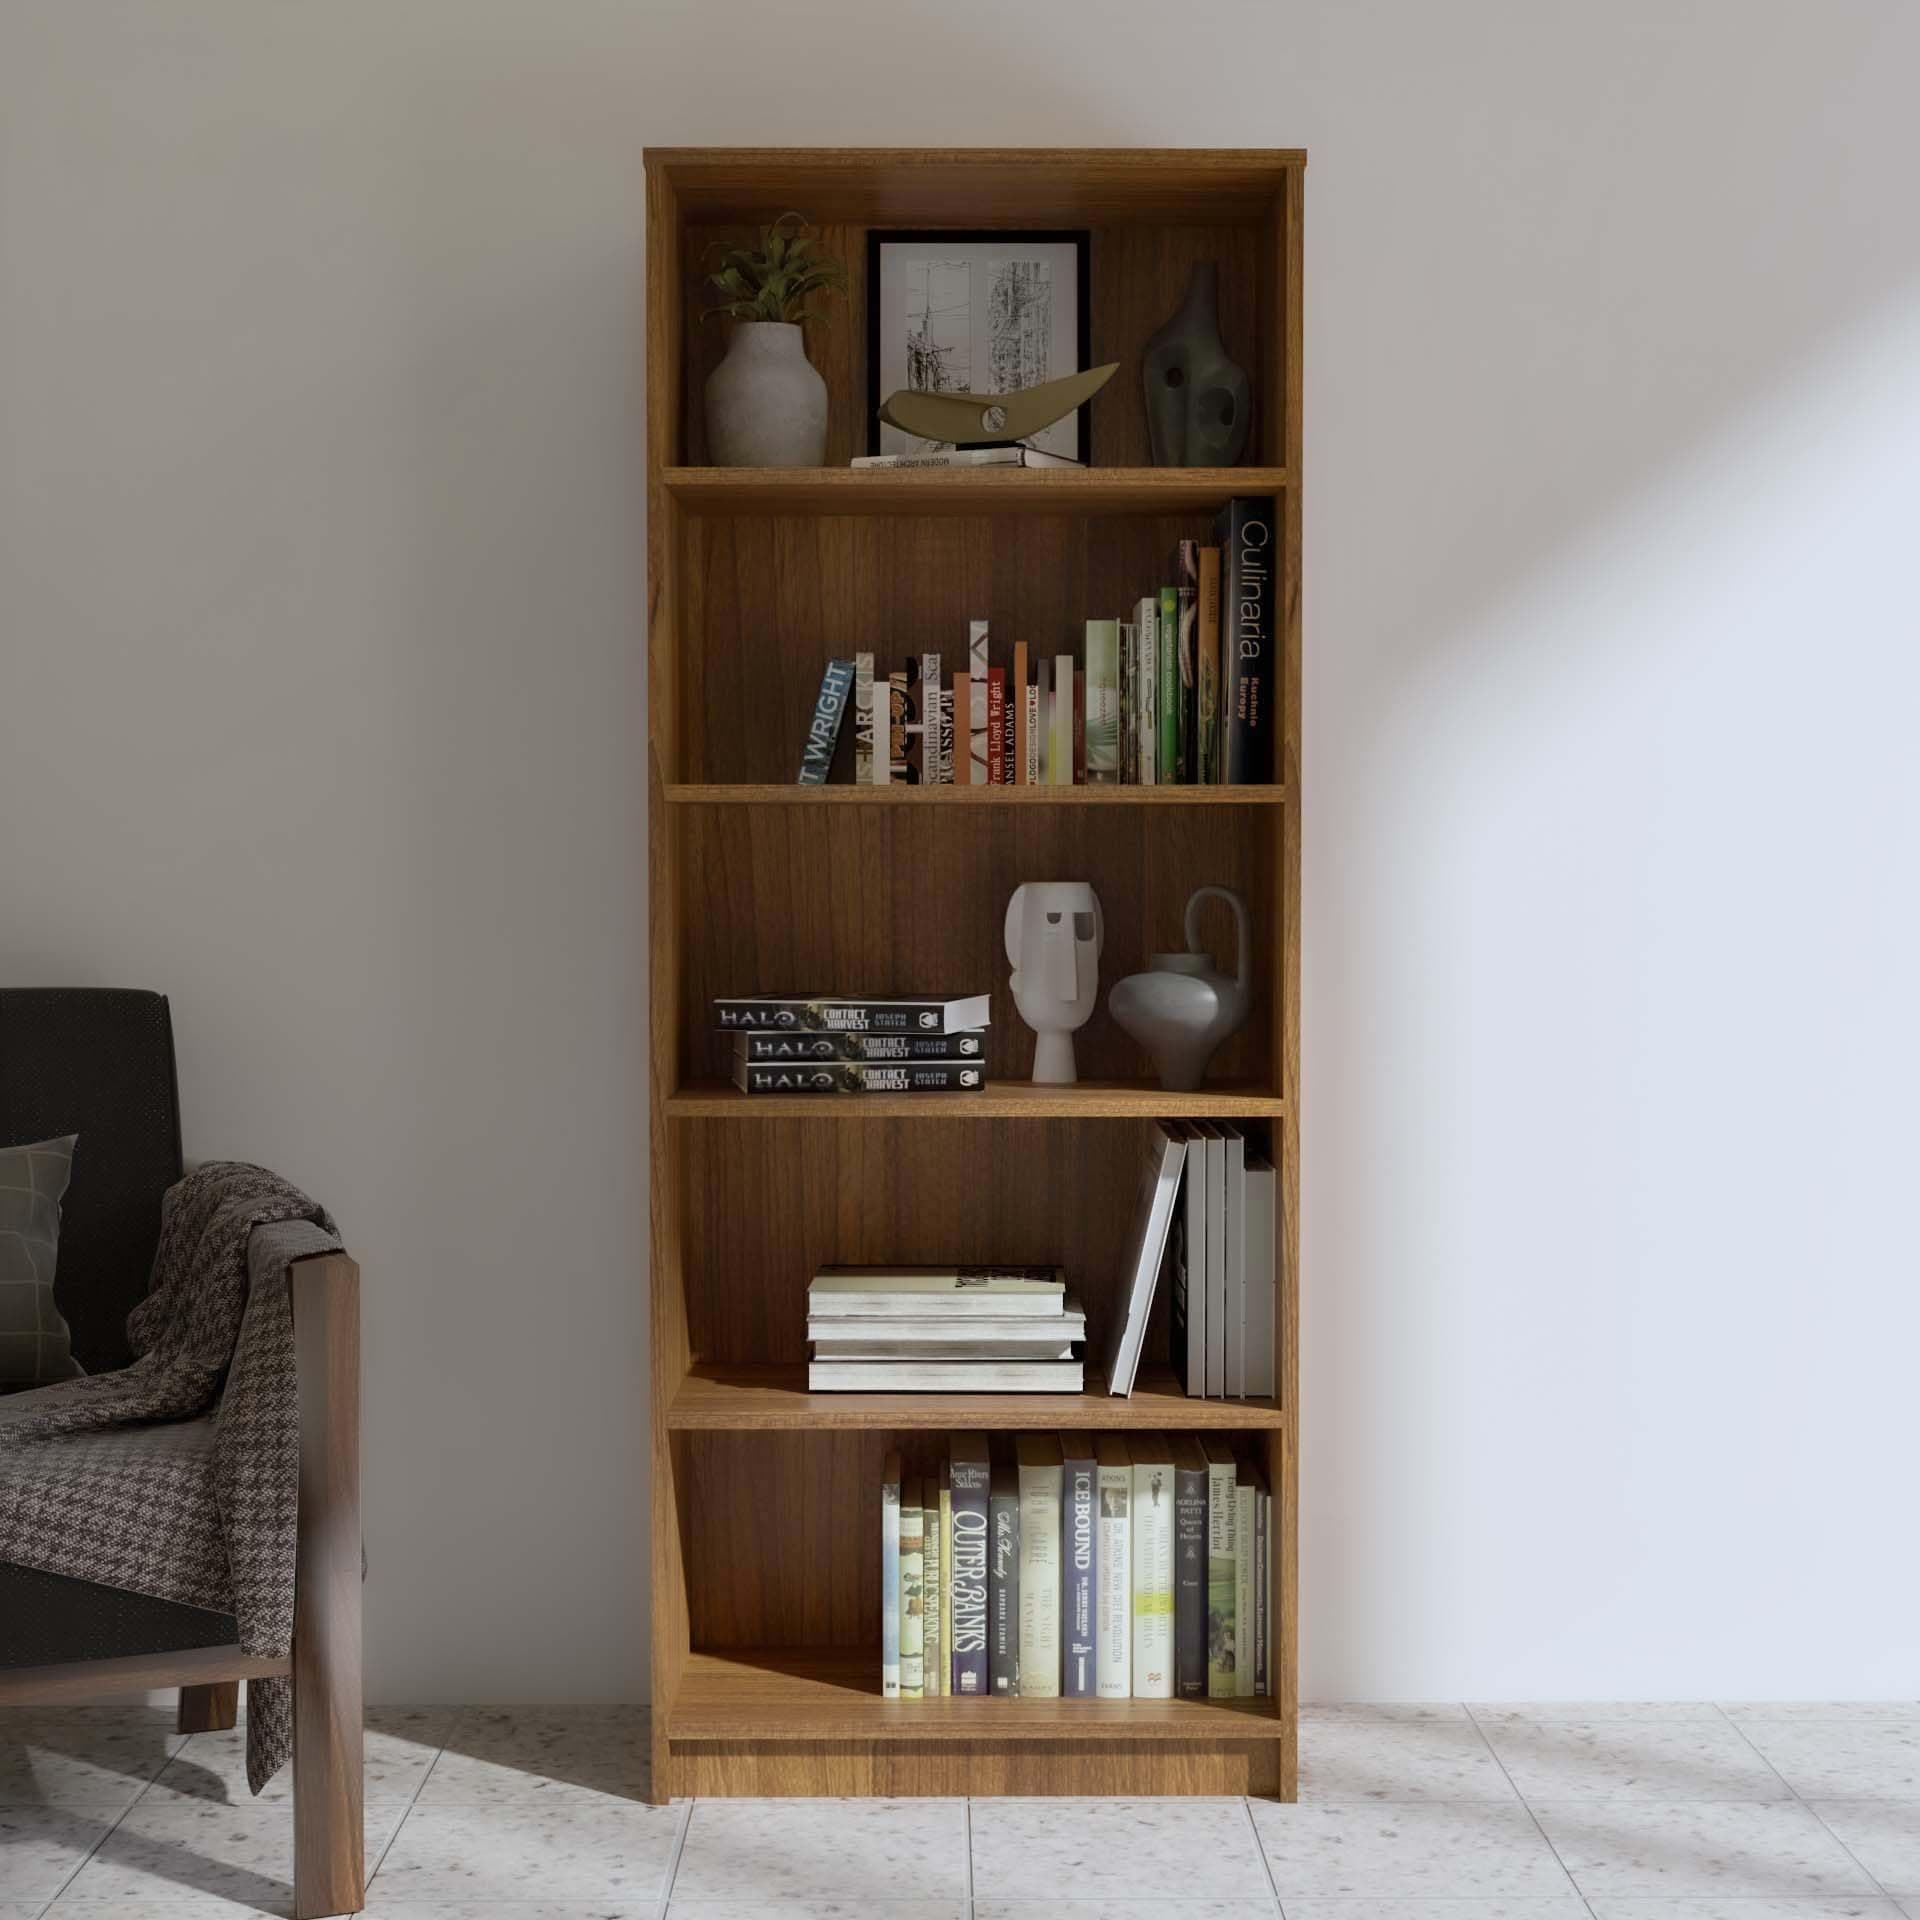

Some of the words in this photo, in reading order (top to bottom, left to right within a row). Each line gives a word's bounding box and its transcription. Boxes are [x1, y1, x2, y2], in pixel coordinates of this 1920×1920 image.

[1239, 520, 1269, 660] Culinaria
[803, 661, 847, 761] WRIGHT
[989, 681, 1003, 716] Wright
[1237, 676, 1249, 720] Europy
[989, 722, 1001, 753] Lloyd
[1004, 703, 1015, 746] ADAMS
[720, 1009, 797, 1026] HALO
[755, 1041, 834, 1057] HALO
[754, 1072, 833, 1089] HALO
[1074, 1471, 1091, 1501] ICE
[953, 1510, 988, 1580] OUTER
[1074, 1502, 1091, 1570] BOUND
[924, 1593, 940, 1644] SPEAKING
[951, 1580, 988, 1653] BANKS
